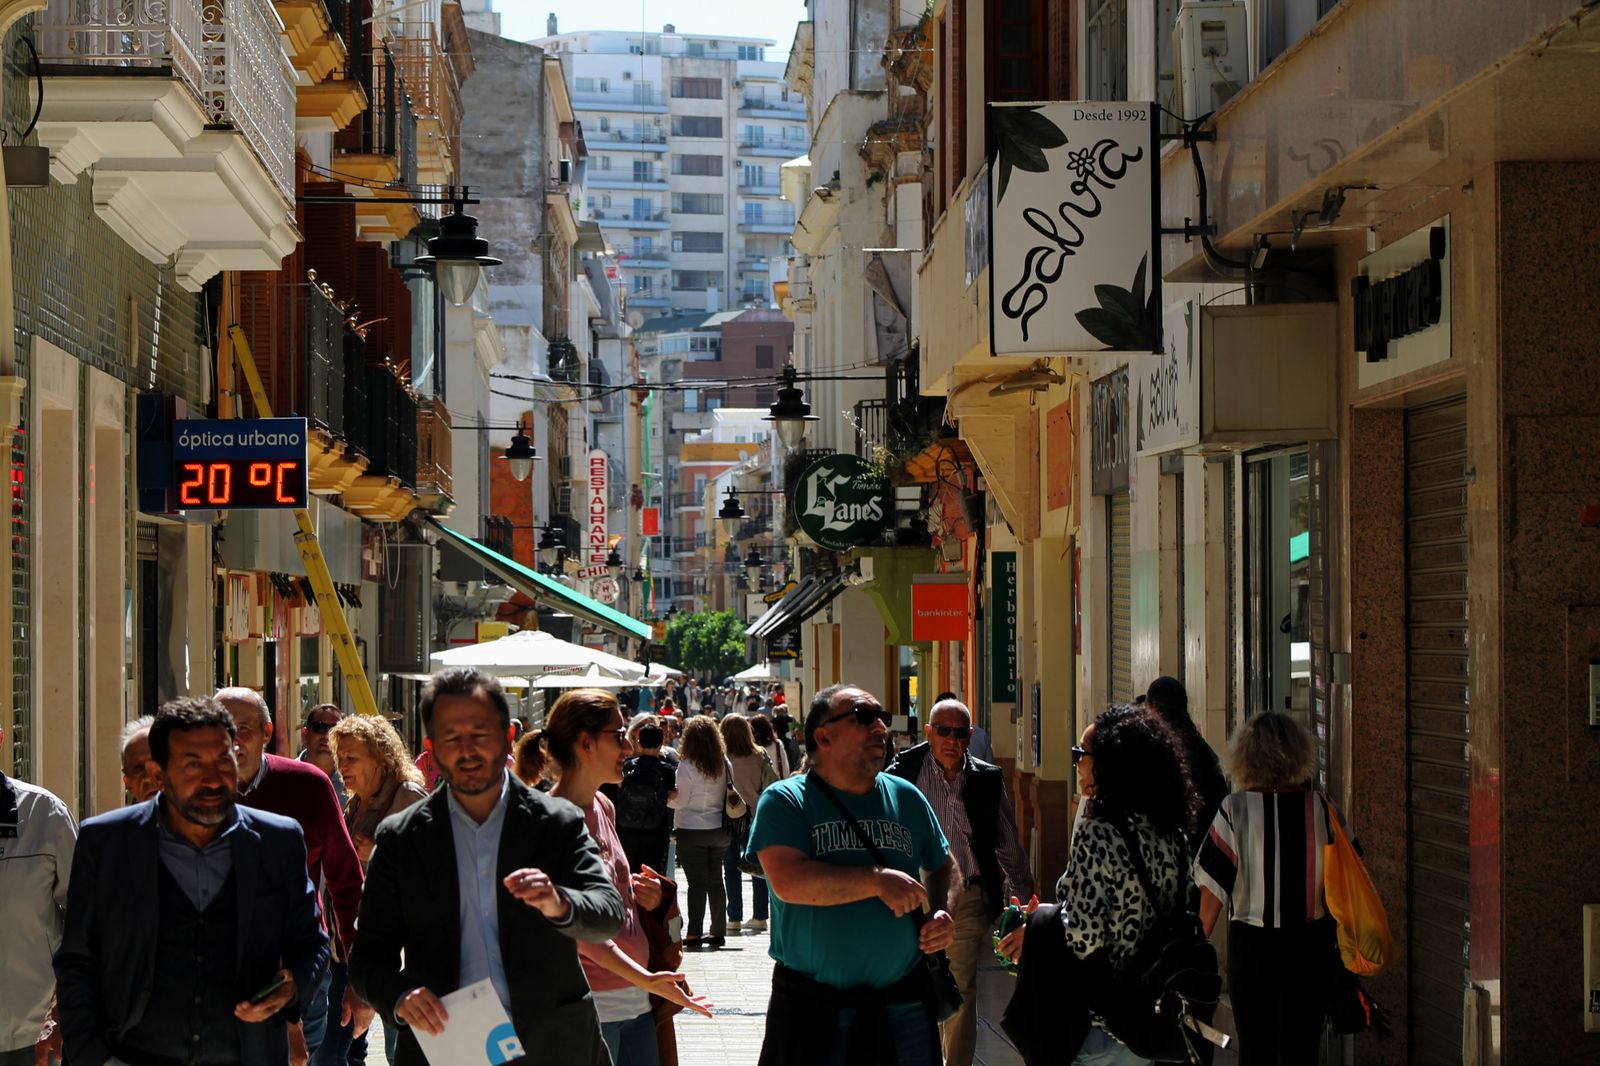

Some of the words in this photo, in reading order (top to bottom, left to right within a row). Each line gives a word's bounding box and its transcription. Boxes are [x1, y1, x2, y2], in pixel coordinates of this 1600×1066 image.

[1073, 109, 1113, 121] Desde
[1118, 109, 1147, 121] 1992
[179, 429, 234, 450] óptica
[238, 429, 300, 446] urbano
[181, 463, 232, 504] 20
[590, 458, 605, 563] RESTAURANTE
[917, 608, 964, 617] bankinter
[1005, 561, 1016, 692] Herbolario
